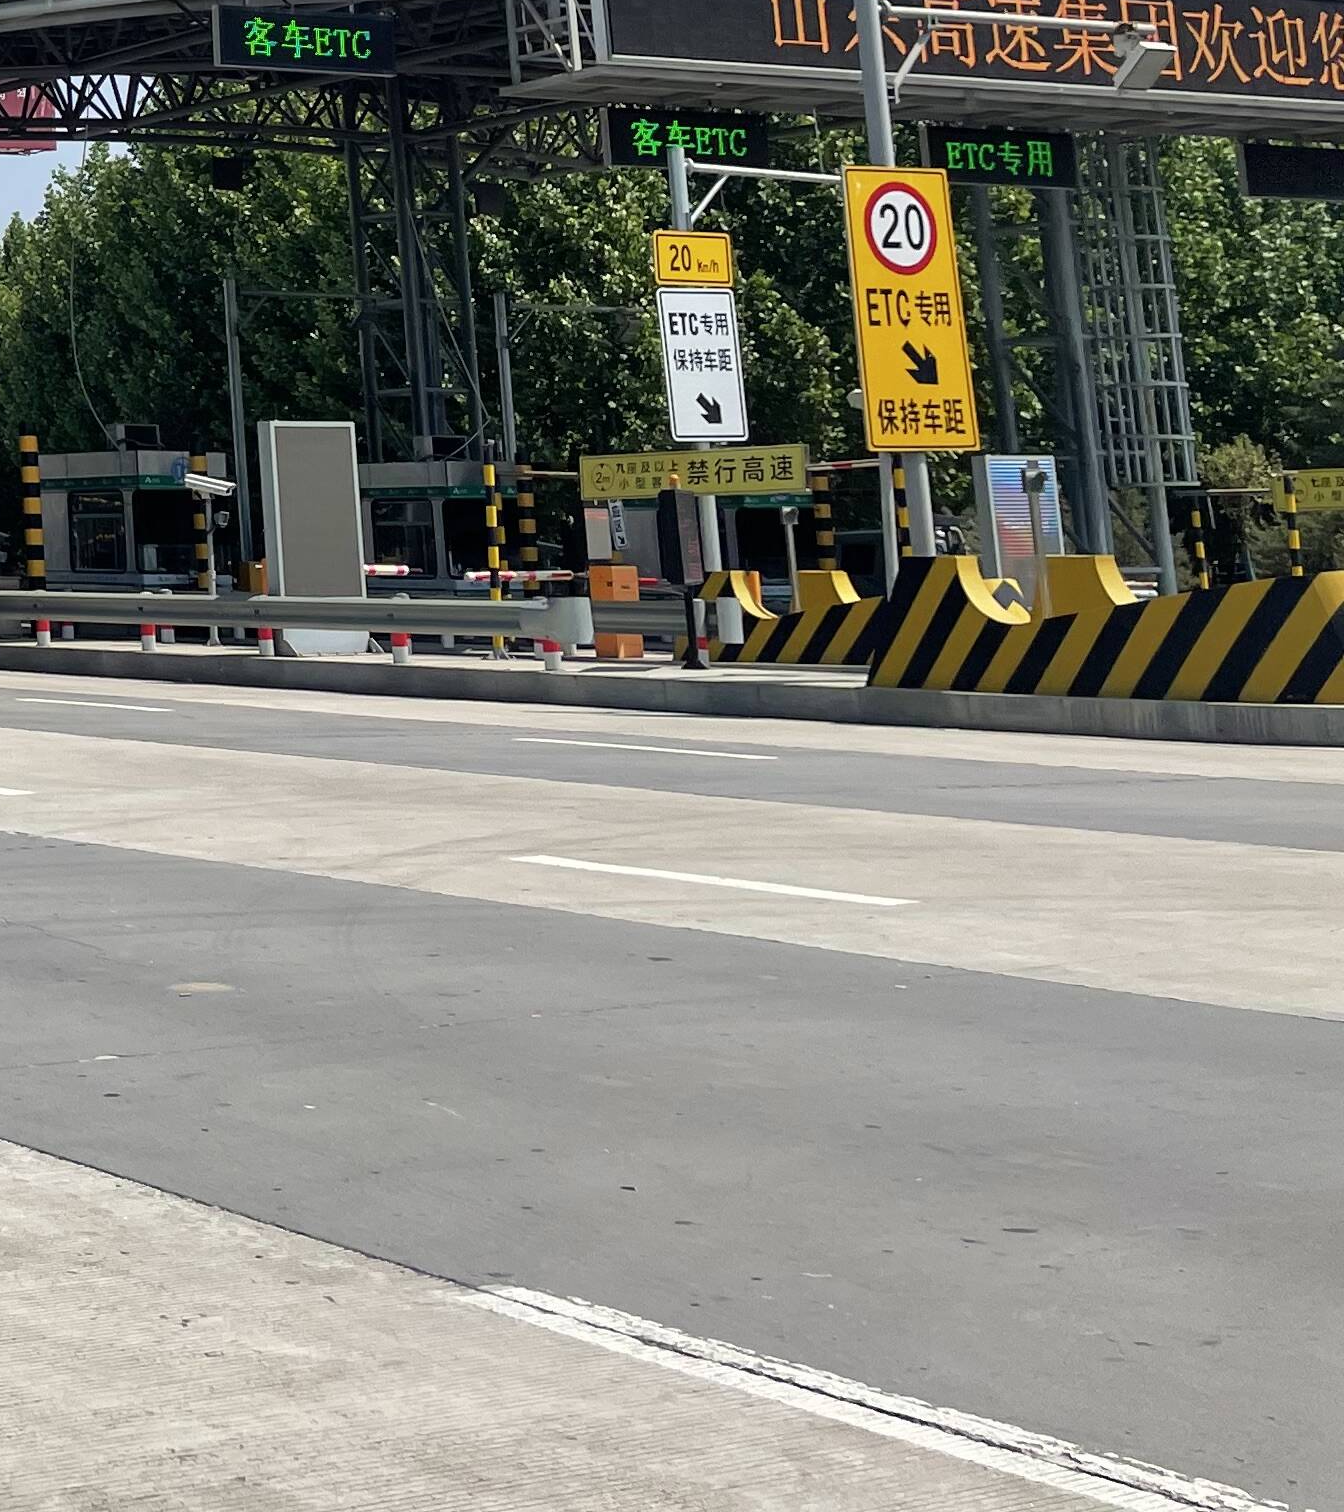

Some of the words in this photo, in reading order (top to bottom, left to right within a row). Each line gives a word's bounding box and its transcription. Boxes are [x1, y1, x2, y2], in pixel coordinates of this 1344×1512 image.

[243, 16, 372, 59] 客车ETC
[945, 140, 1054, 177] ETC专用
[879, 203, 926, 251] 20
[669, 244, 691, 271] 20
[673, 348, 733, 372] 保持车距
[877, 398, 966, 435] 保持车距
[687, 454, 795, 485] 禁行高速
